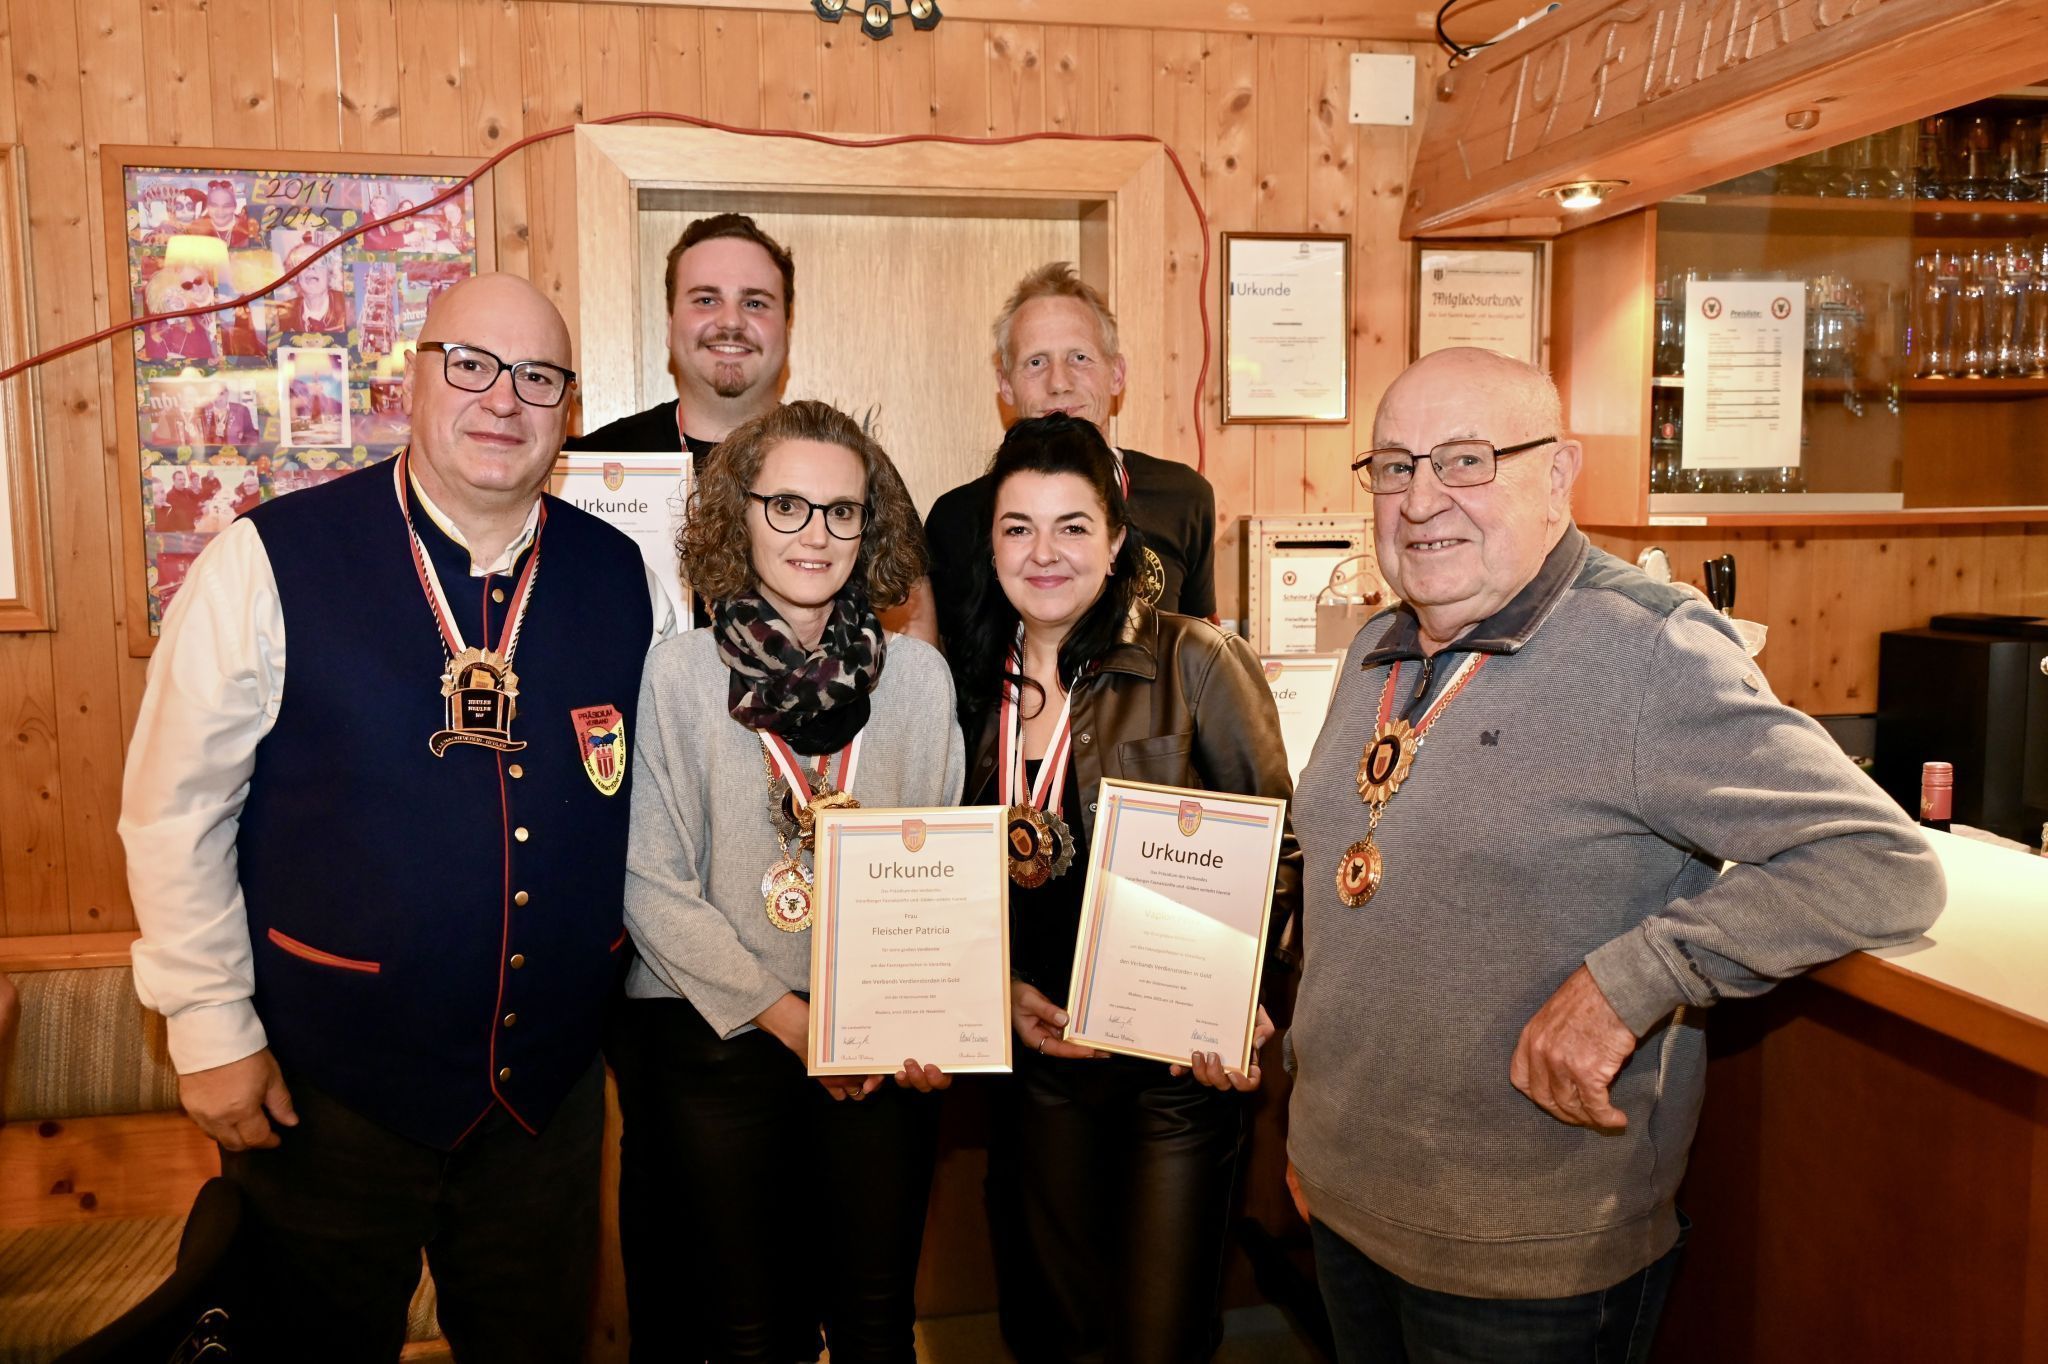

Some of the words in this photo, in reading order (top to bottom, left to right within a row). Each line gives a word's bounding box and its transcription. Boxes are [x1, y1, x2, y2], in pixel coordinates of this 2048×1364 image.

[266, 178, 334, 204] 2014
[266, 205, 353, 229] 2015
[1236, 281, 1291, 297] Urkunde
[575, 498, 648, 514] Urkunde
[577, 709, 613, 720] PRÄSIDIUM
[1141, 841, 1224, 869] Urkunde
[869, 860, 955, 879] Urkunde
[872, 926, 913, 936] Fleischer
[915, 926, 950, 935] Patricia
